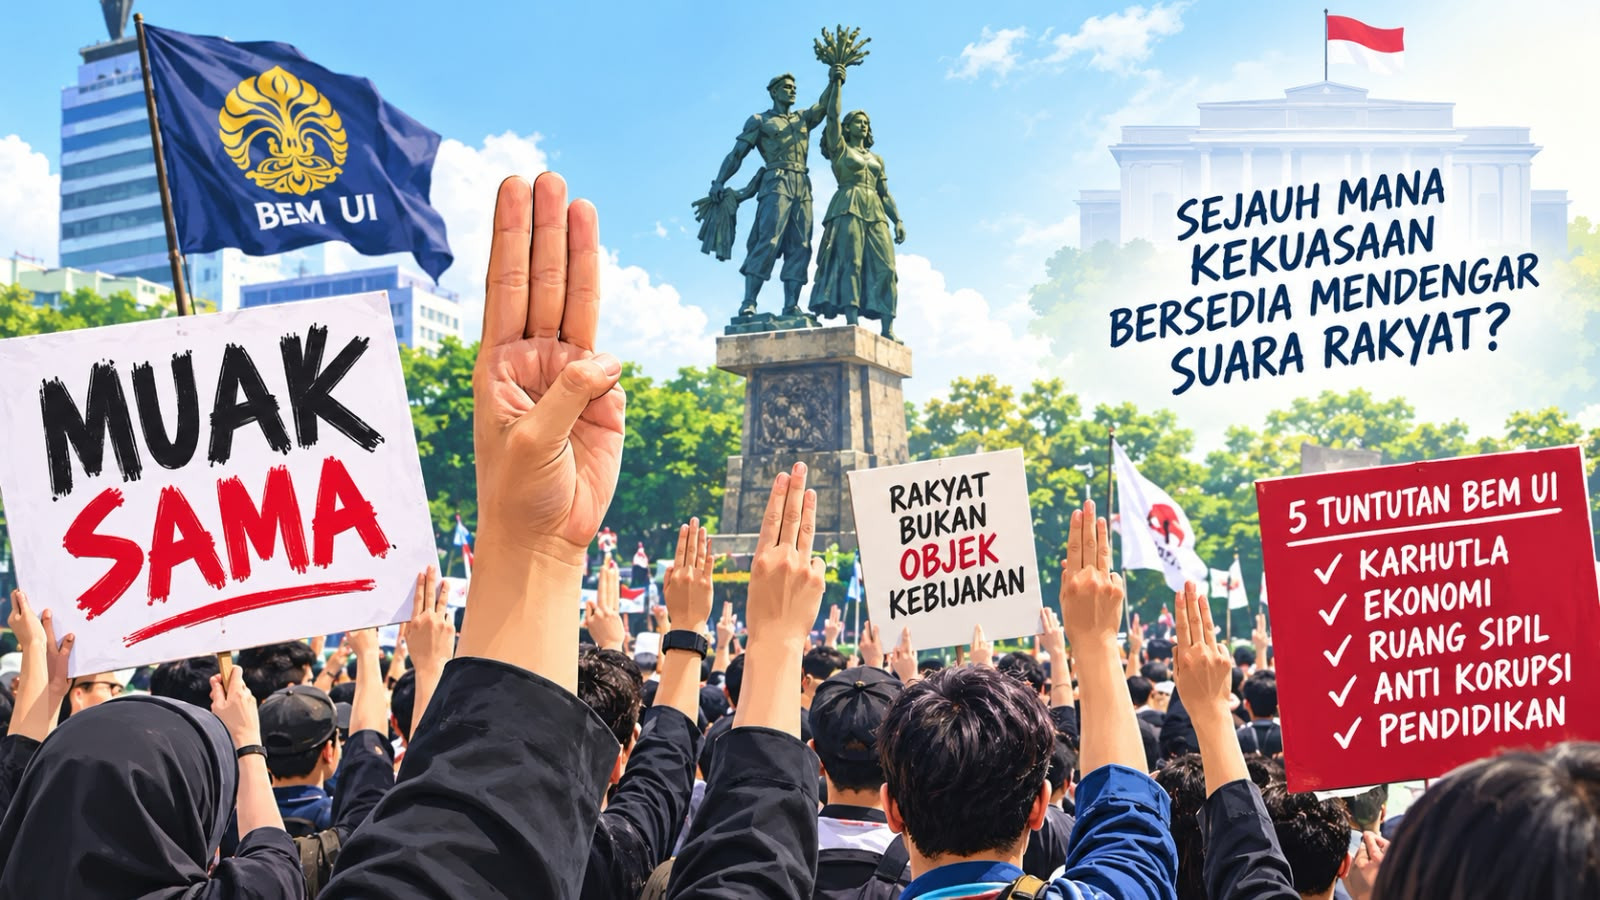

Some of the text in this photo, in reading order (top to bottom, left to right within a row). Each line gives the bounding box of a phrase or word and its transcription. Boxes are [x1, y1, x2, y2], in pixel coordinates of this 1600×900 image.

[255, 193, 378, 231] BEM UI
[40, 322, 385, 497] MUAK
[889, 471, 990, 514] RAKYAT
[1289, 472, 1558, 534] 5 TUNTUTAN BEM UI
[62, 455, 391, 621] SAMA
[899, 502, 987, 546] BUKAN
[900, 533, 1000, 581] OBJEK
[1359, 536, 1509, 581] KARHUTLA
[889, 565, 1025, 620] KEBIJAKAN
[1364, 577, 1491, 622] EKONOMI
[1369, 614, 1550, 663] RUANG SIPIL
[1374, 652, 1571, 705] ANTI KORUPSI
[1379, 695, 1566, 748] PENDIDIKAN
